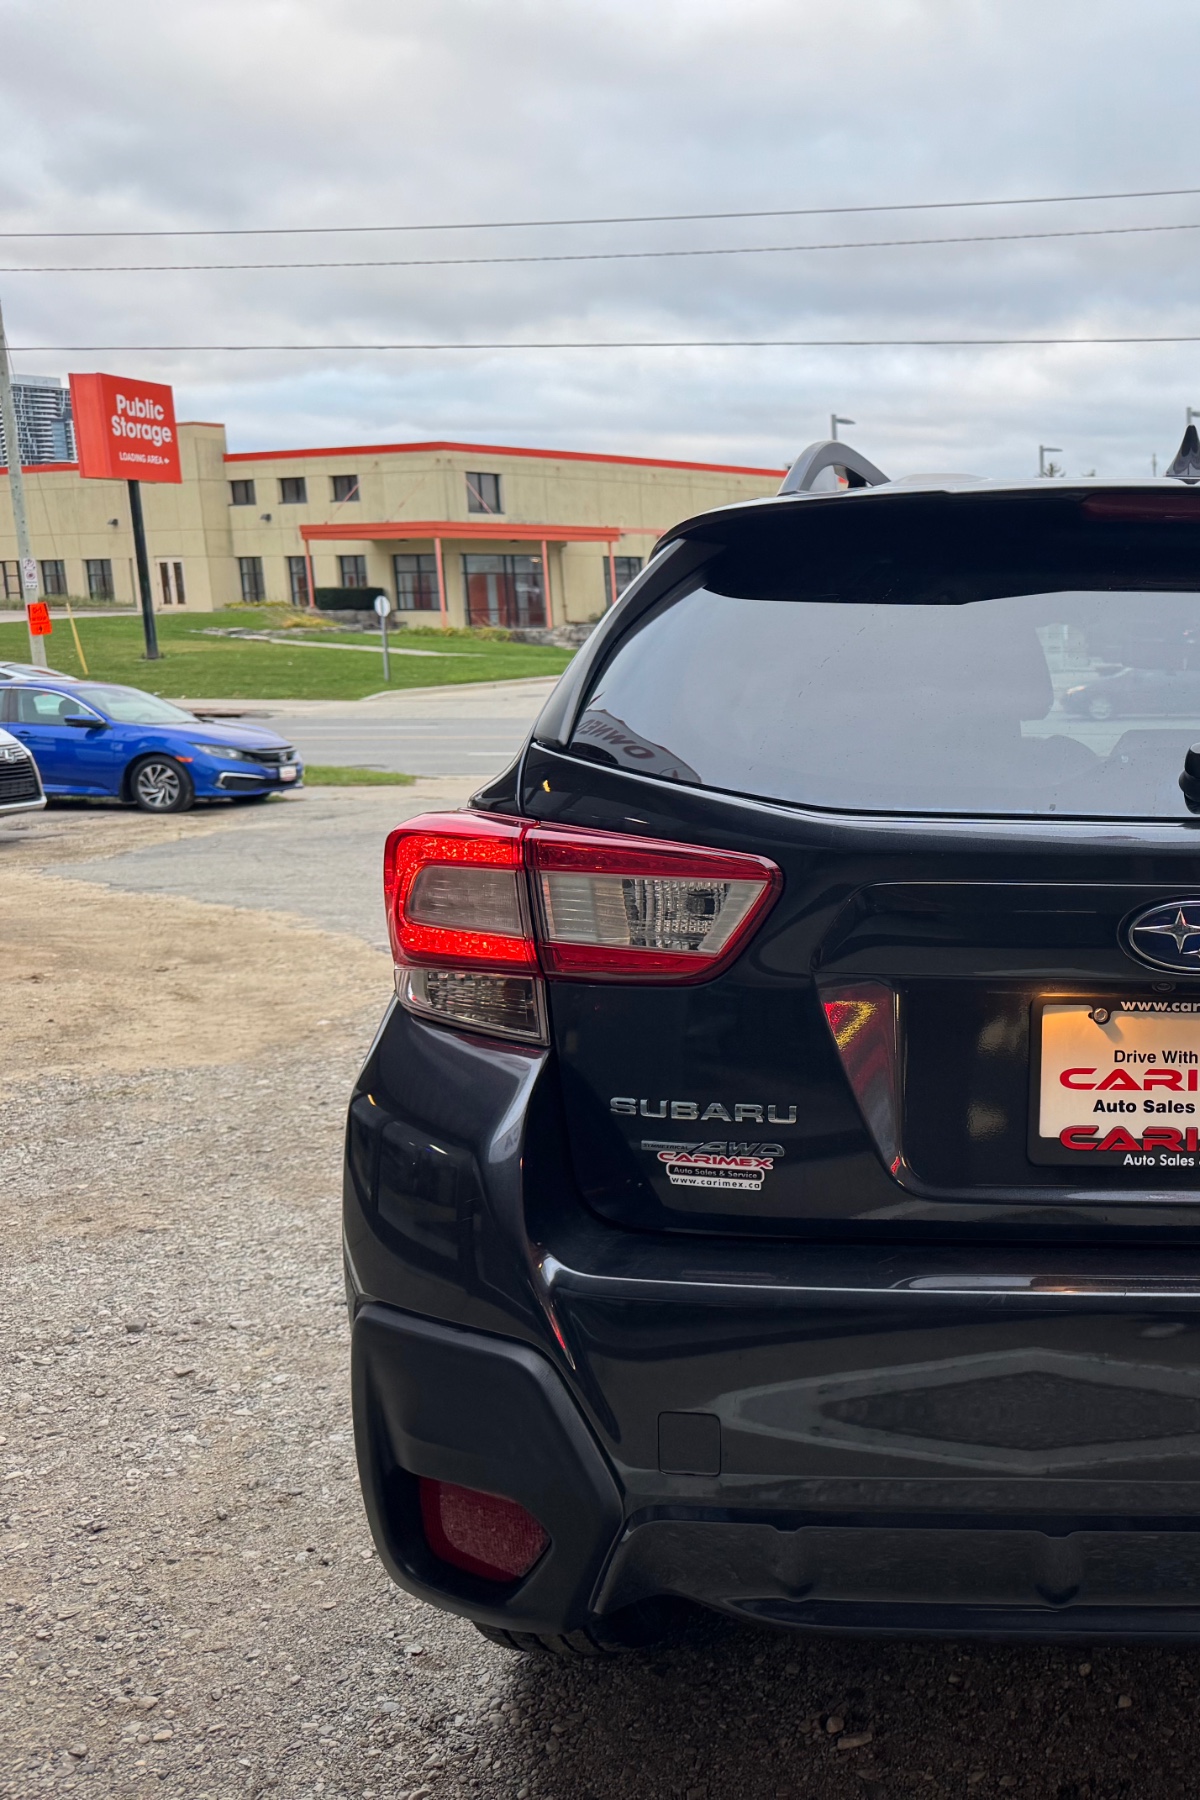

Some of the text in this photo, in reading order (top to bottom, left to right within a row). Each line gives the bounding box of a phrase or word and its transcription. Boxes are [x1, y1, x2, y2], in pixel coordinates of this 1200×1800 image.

[115, 394, 164, 421] Public
[111, 415, 172, 447] Storage
[119, 452, 164, 465] LOADING AREA
[1113, 1050, 1157, 1064] Drive
[1161, 1050, 1199, 1065] With
[609, 1096, 798, 1125] SUBARU
[1093, 1099, 1137, 1114] Auto
[1142, 1099, 1196, 1114] Sales
[642, 1140, 786, 1157] SYMMETRICAL AWD
[658, 1152, 773, 1169] CARIMEX
[1123, 1153, 1156, 1167] Auto
[1159, 1153, 1196, 1167] Sales
[673, 1166, 758, 1179] Auto Sales & Service
[671, 1176, 761, 1189] www.carimex.ca
